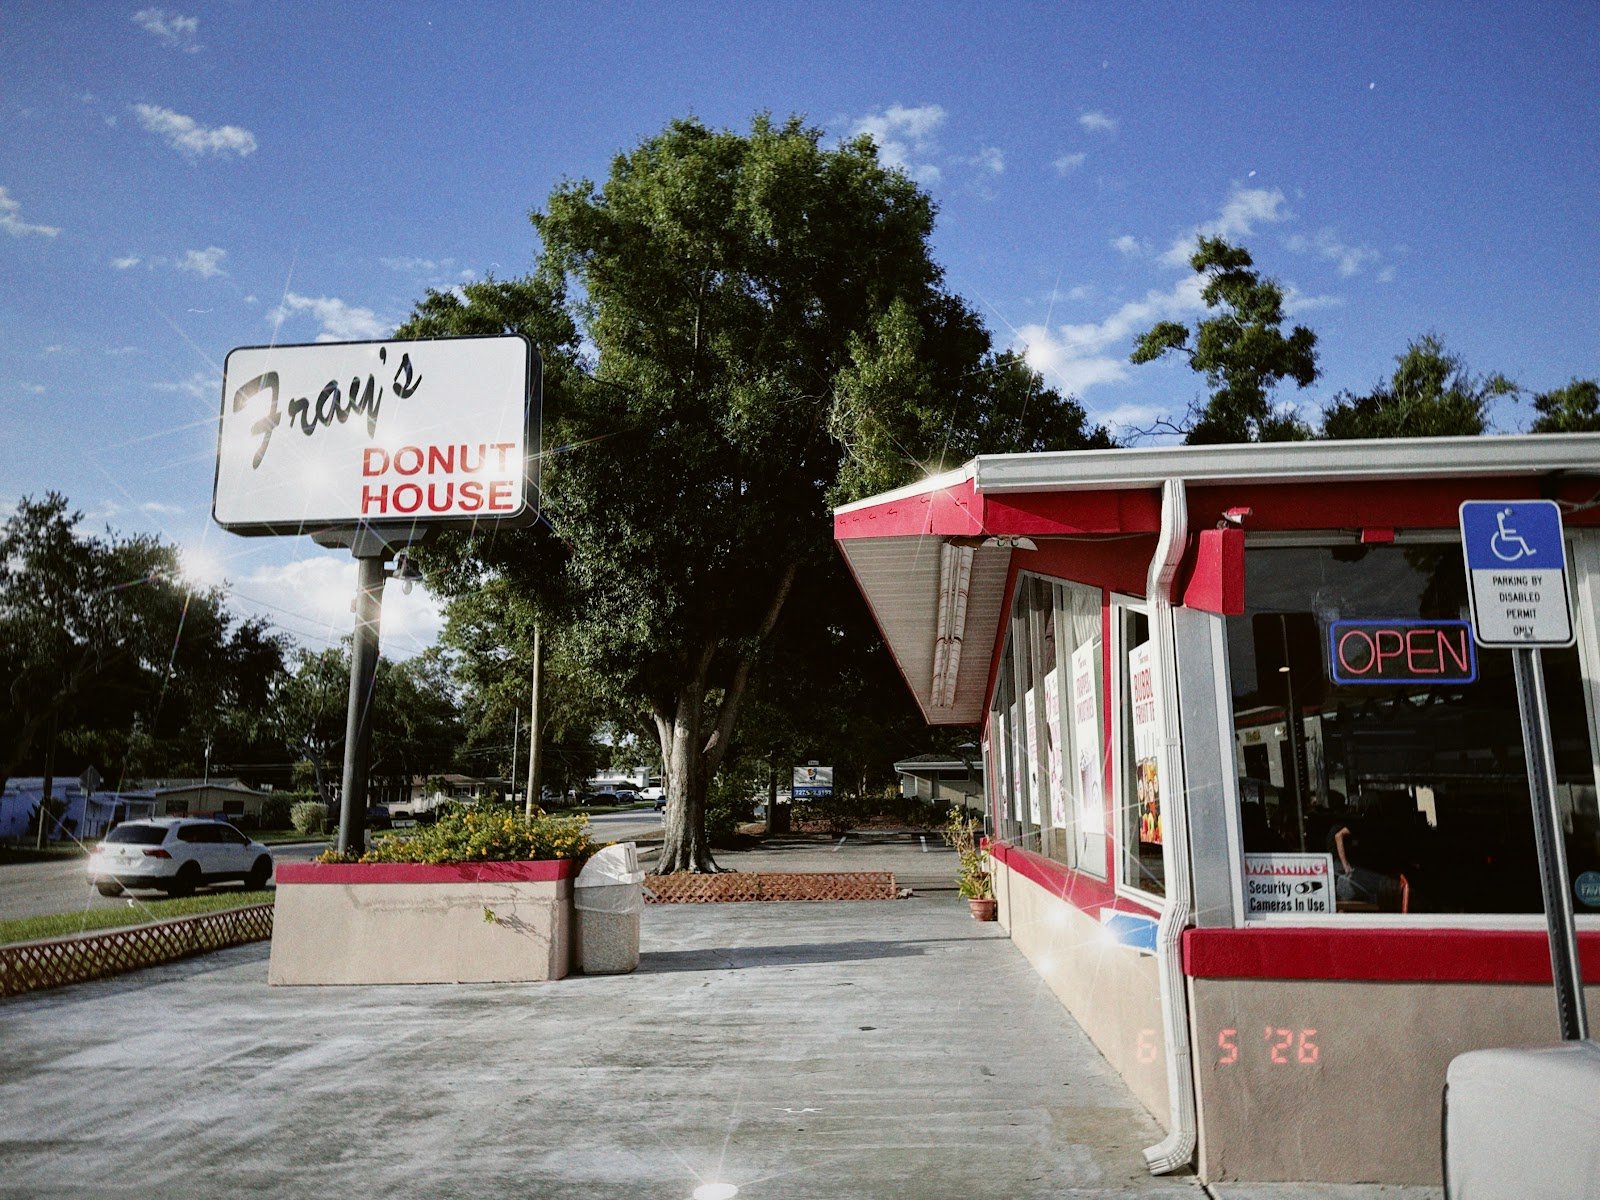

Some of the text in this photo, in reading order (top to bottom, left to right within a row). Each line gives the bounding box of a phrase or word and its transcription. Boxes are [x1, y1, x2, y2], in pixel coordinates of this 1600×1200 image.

[233, 346, 422, 469] Fray's
[362, 443, 516, 477] DONUT
[361, 480, 513, 514] HOUSE
[1492, 576, 1542, 586] PARKING BY
[1499, 592, 1540, 602] DISABLED
[1506, 608, 1537, 619] PERMIT
[1513, 625, 1534, 637] ONLY
[1338, 629, 1468, 674] OPEN
[1249, 880, 1292, 897] Security
[1250, 898, 1325, 911] Cameras In Use
